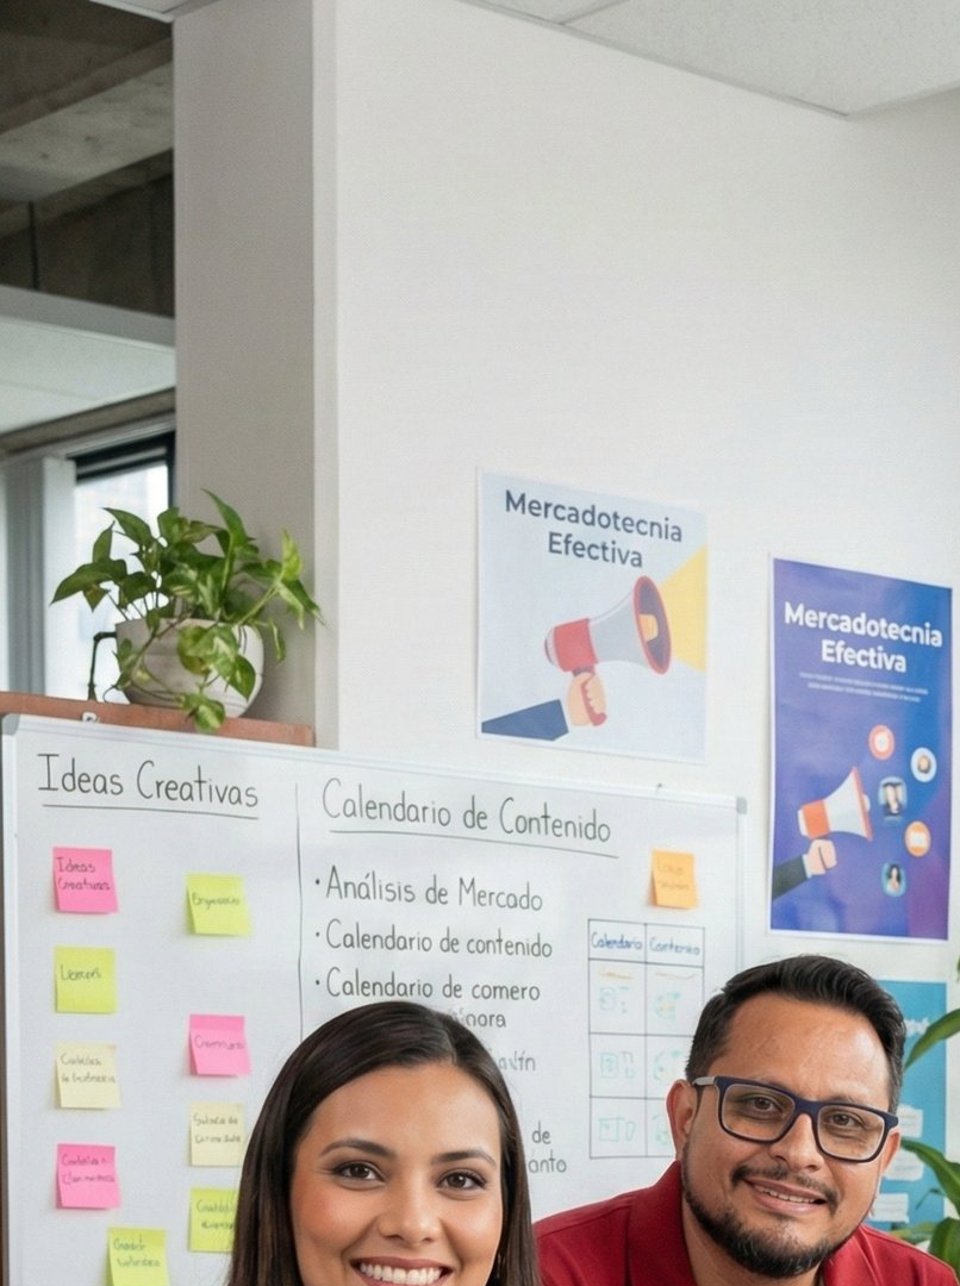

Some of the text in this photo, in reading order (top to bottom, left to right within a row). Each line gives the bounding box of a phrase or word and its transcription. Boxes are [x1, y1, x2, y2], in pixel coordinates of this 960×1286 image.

[505, 489, 683, 542] Mercadotecnia
[548, 531, 643, 568] Efectiva
[784, 601, 943, 647] Mercadotecnia
[821, 638, 907, 673] Efectiva
[37, 753, 259, 808] Ideas Creativas
[322, 777, 611, 843] Calendario de Contenido
[325, 864, 543, 911] Análisis de Mercado
[326, 918, 553, 958] Calendario de contenido
[326, 966, 434, 998] Calendario
[442, 973, 462, 1000] de
[531, 1120, 552, 1145] de
